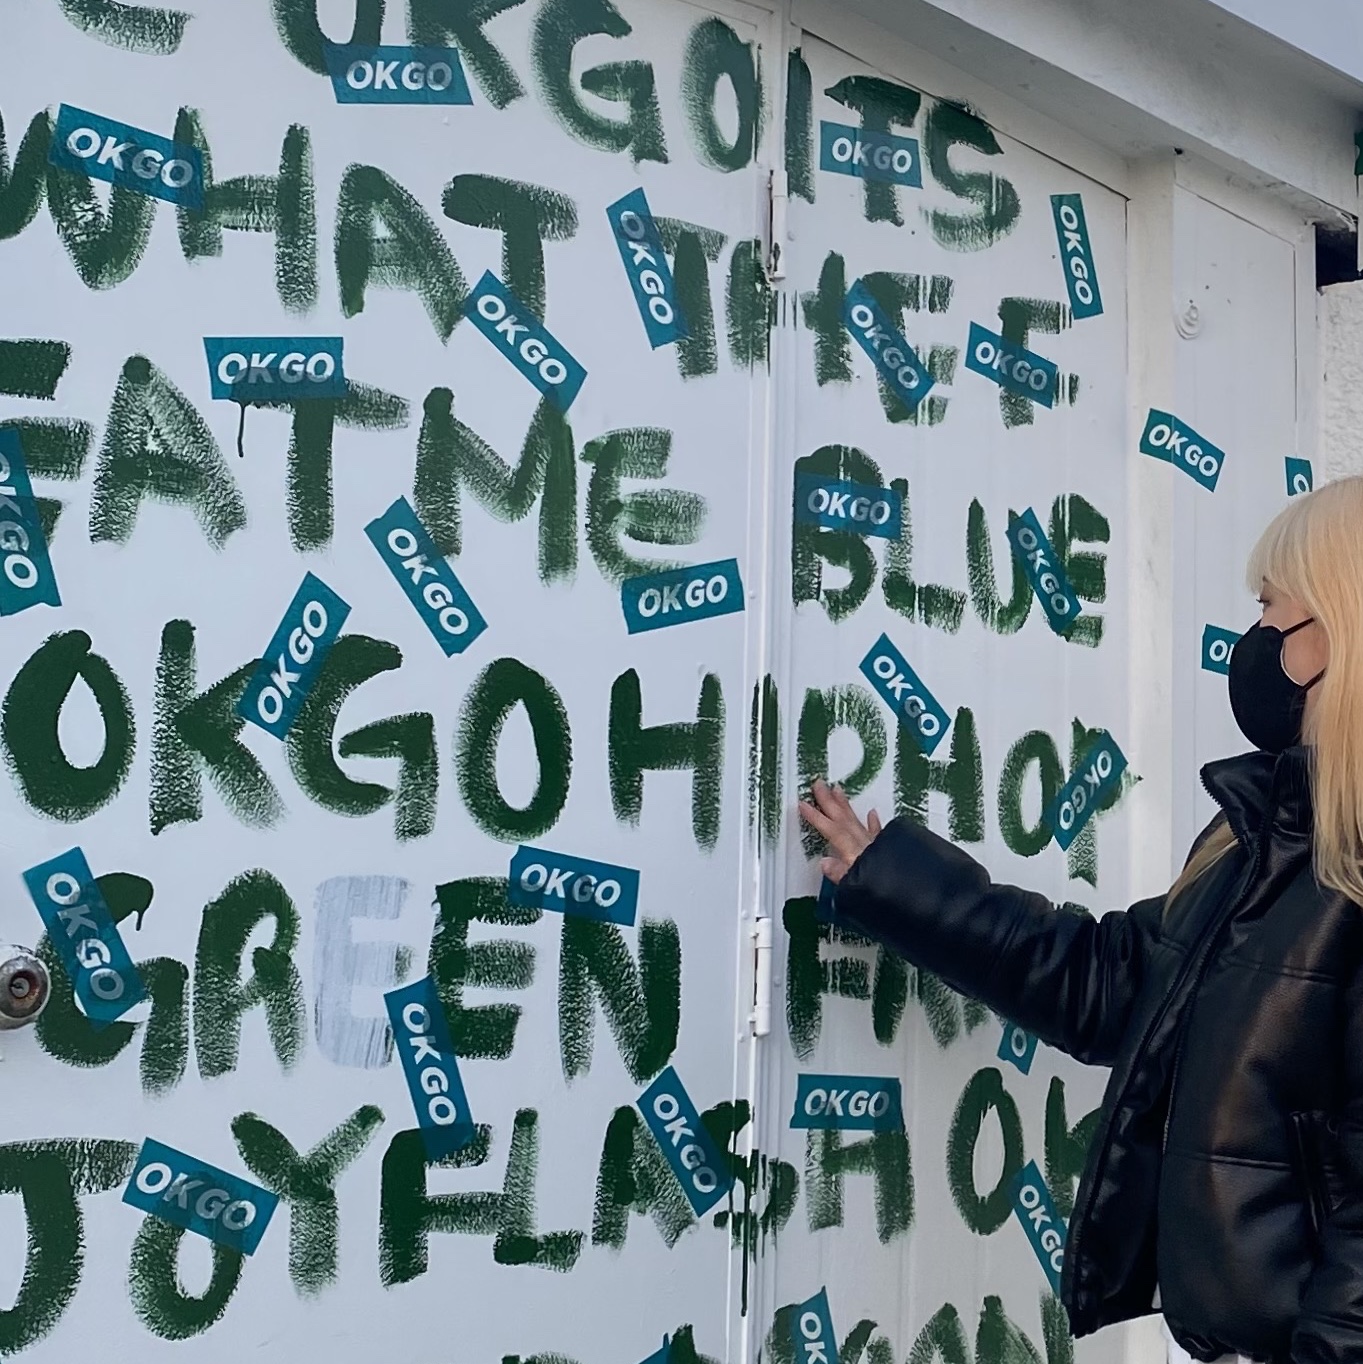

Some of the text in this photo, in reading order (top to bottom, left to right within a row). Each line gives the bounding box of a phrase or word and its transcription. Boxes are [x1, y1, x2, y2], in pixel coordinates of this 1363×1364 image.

[346, 60, 452, 92] OKGO
[66, 127, 193, 188] OKGO
[831, 137, 912, 173] OKGO
[620, 210, 673, 324] OKGO
[1059, 205, 1093, 306] OKGO
[217, 351, 335, 384] OKGO
[476, 294, 568, 385] OKGO
[850, 304, 920, 390] OKGO
[974, 342, 1048, 391] OKGO
[1149, 424, 1218, 477] OKGO
[808, 487, 890, 524] OKGO
[387, 528, 469, 636] OKGO
[637, 574, 728, 618] OKGO
[1017, 527, 1070, 615] OKGO
[257, 601, 327, 723] OKGO
[873, 656, 940, 737] OKGO
[521, 862, 621, 907] OKGO
[46, 872, 123, 1001] OKGO
[402, 1001, 456, 1127] OKGO
[805, 1088, 890, 1117] OKGO
[652, 1093, 718, 1194] OKGO
[136, 1162, 256, 1230] OKGO
